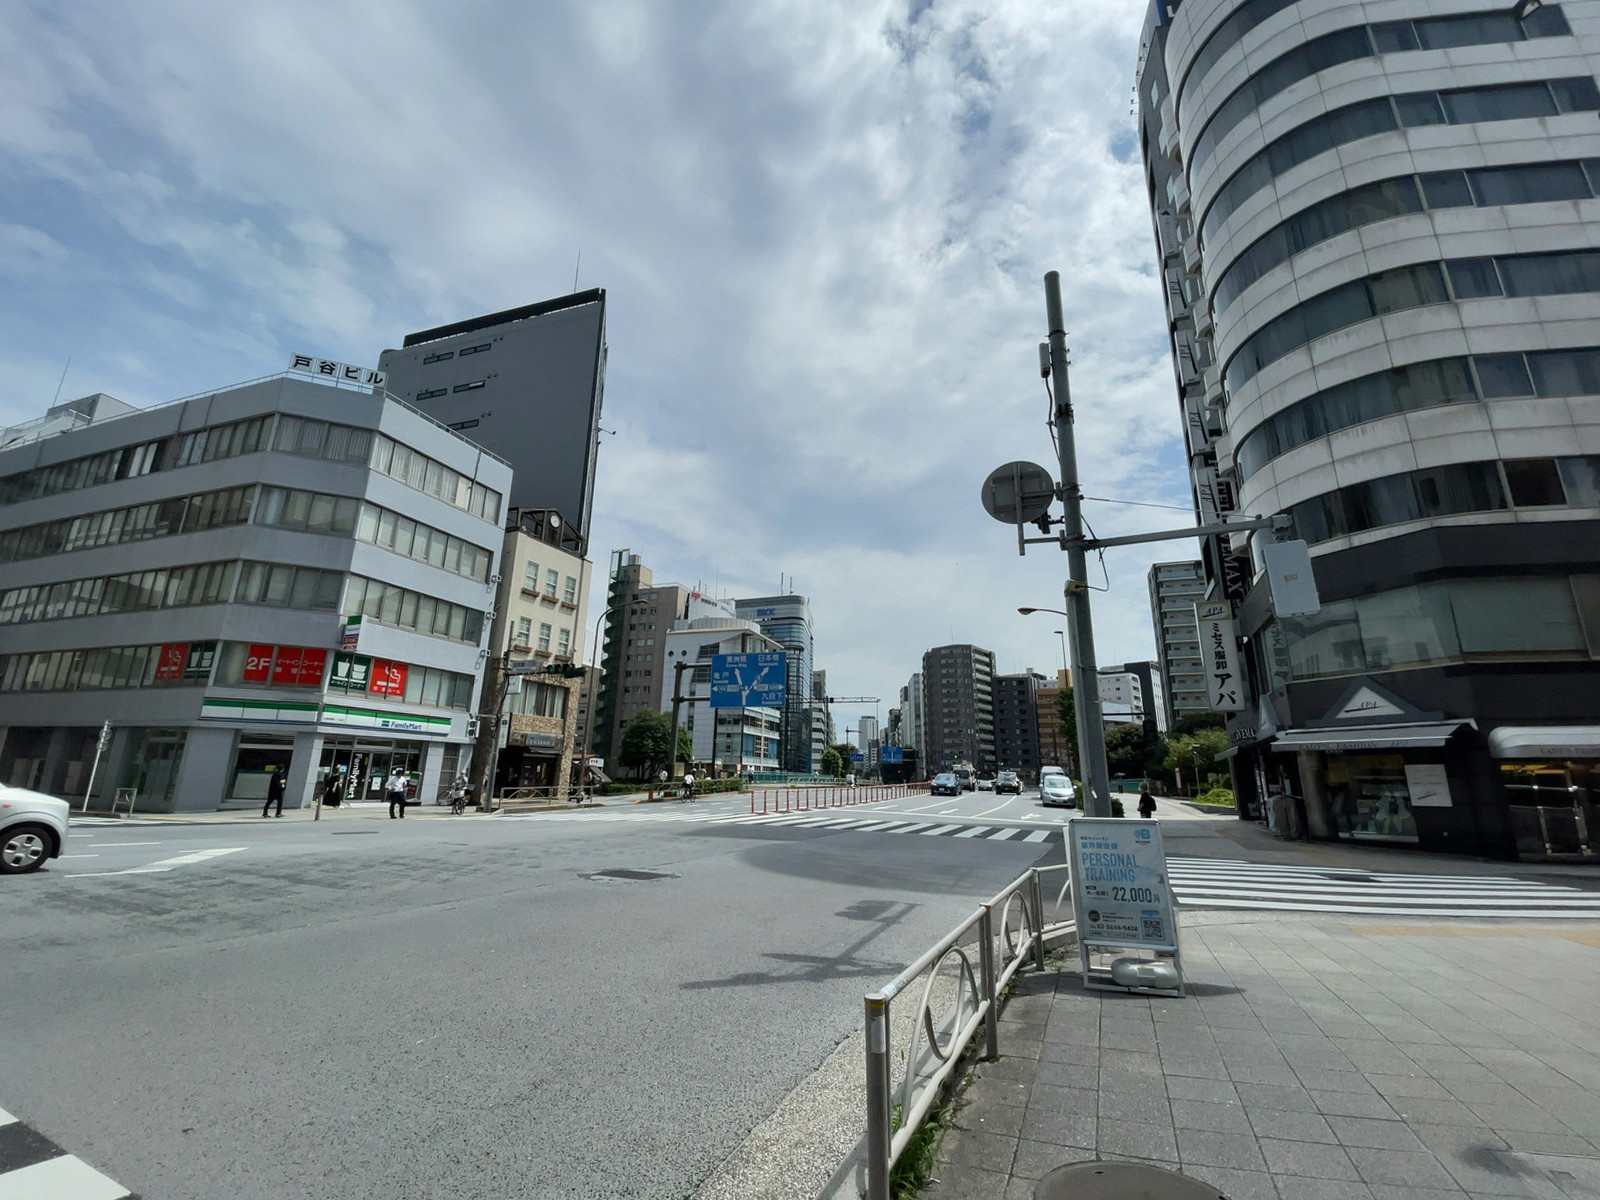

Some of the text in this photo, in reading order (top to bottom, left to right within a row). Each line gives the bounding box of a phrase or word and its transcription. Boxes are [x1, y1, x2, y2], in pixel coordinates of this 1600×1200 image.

[293, 355, 384, 384] 戸谷ビル
[1206, 606, 1224, 616] APA
[1211, 622, 1229, 670] ミセス服卸
[246, 656, 272, 671] 2F
[758, 654, 779, 662] 日本橋
[761, 693, 783, 701] 九段下
[1214, 672, 1238, 706] アパ
[390, 721, 422, 731] FamilyMart
[347, 753, 363, 799] FamilyMart
[1082, 852, 1140, 868] PERSONAL
[1084, 867, 1136, 883] TRAINING
